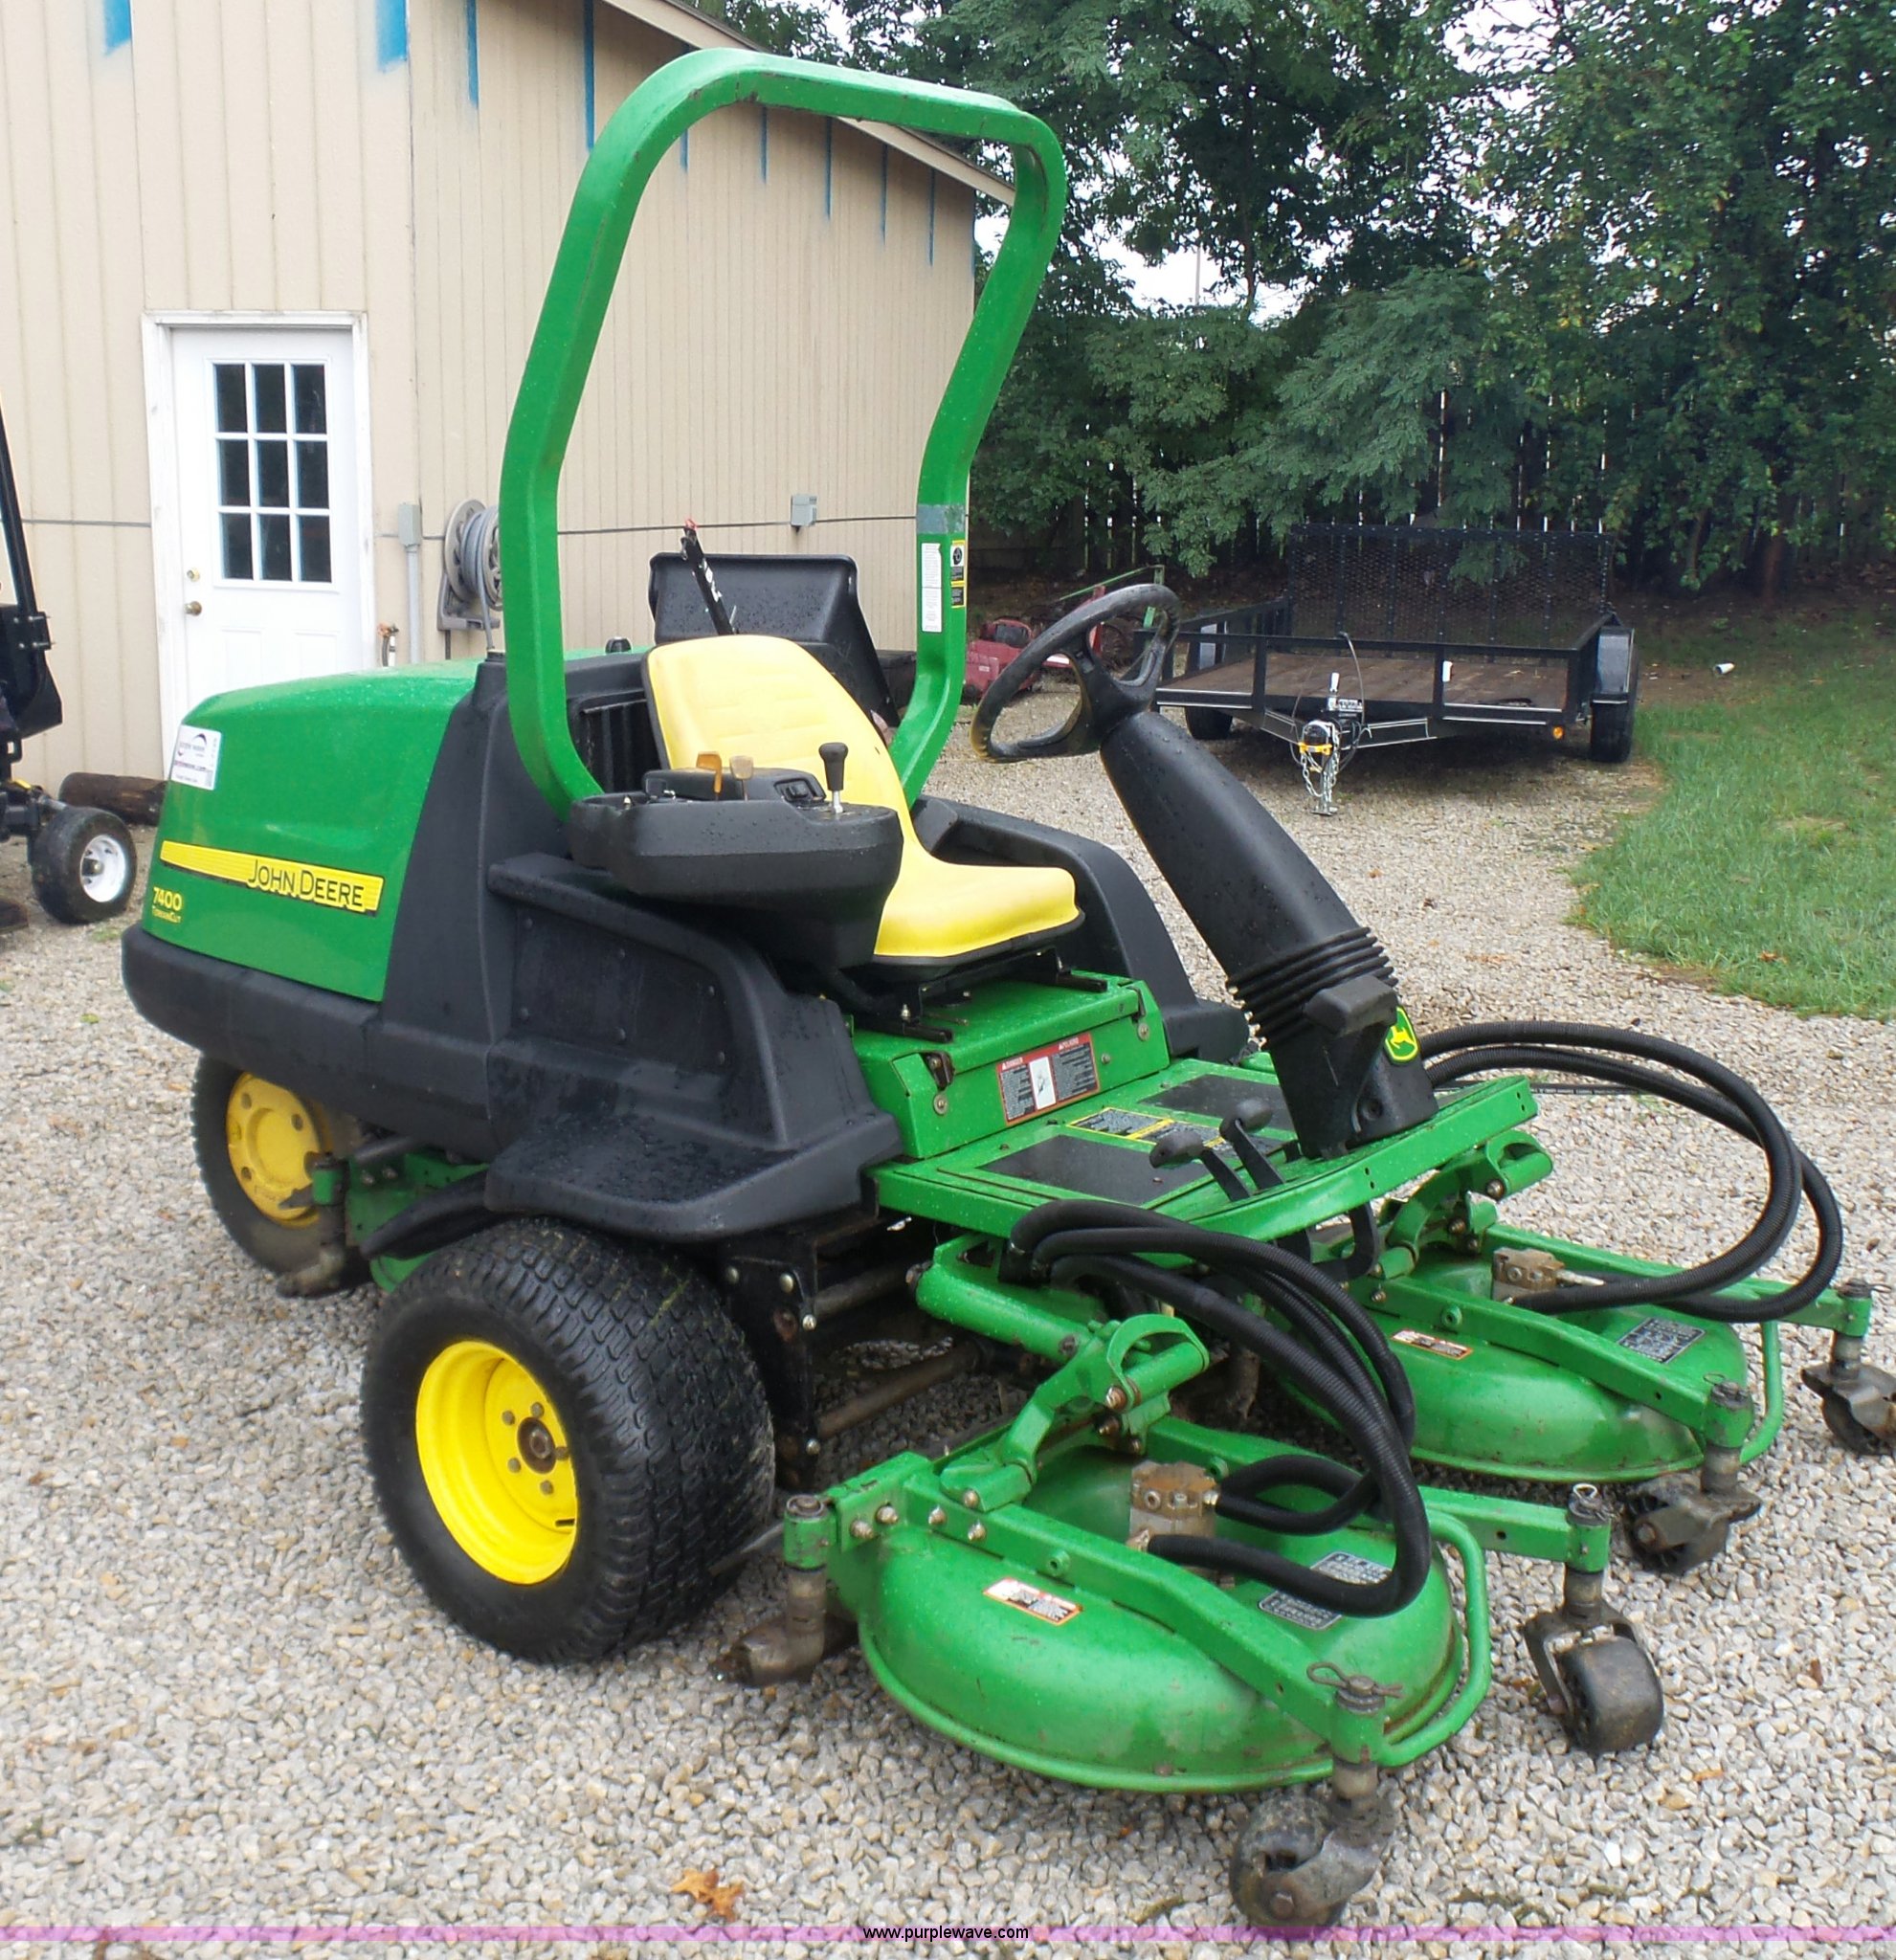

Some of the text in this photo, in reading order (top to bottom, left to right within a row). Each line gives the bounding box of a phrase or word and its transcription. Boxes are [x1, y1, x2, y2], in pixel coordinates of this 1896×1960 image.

[153, 886, 183, 911] 7400
[248, 858, 365, 907] JOHN DEERE
